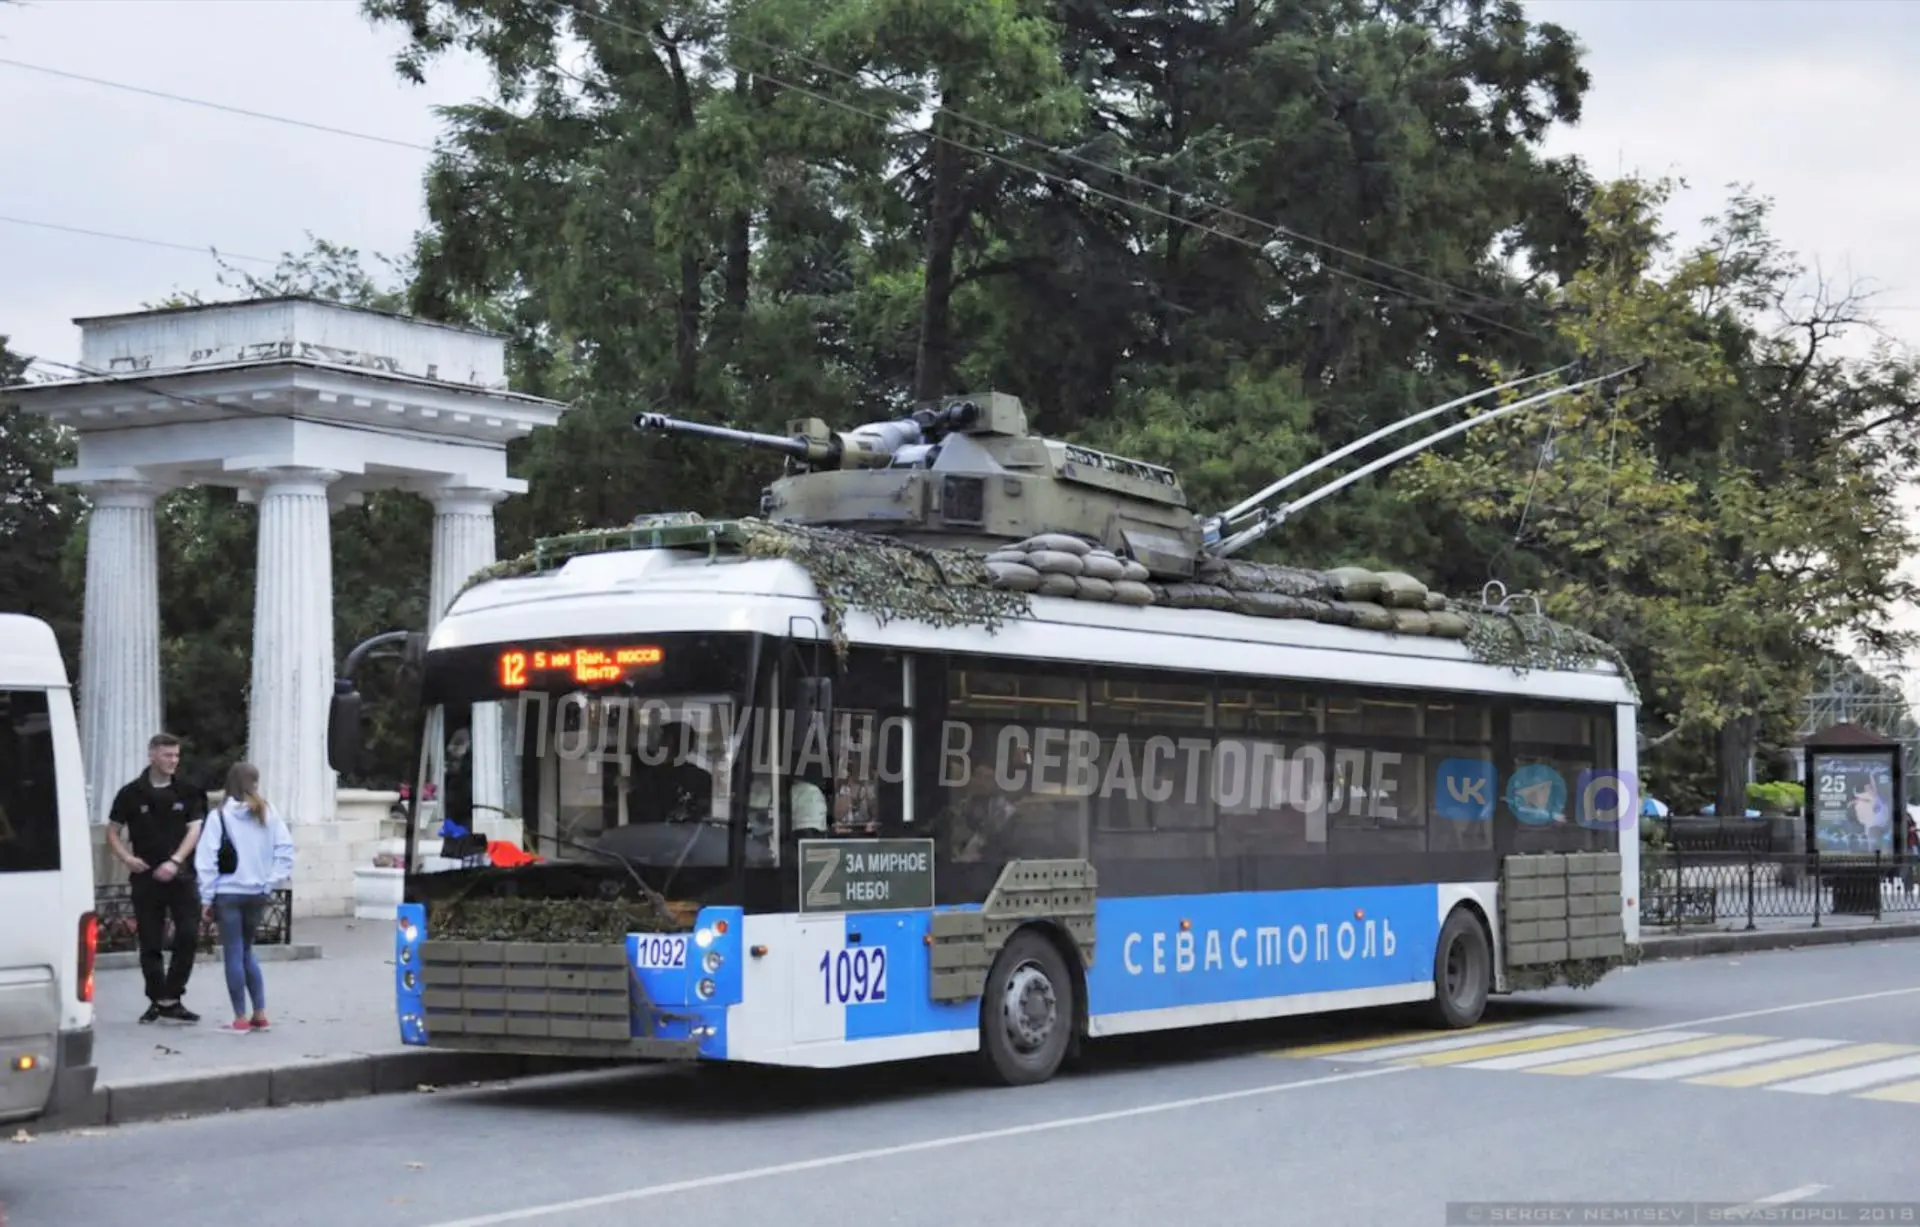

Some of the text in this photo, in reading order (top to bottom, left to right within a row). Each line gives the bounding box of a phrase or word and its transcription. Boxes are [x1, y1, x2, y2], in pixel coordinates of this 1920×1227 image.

[502, 653, 525, 686] 12
[534, 652, 546, 668] 5
[1820, 775, 1847, 793] 25
[845, 852, 927, 873] ЗА МИРНОЕ
[805, 848, 841, 907] Z
[845, 880, 889, 900] НЕБО!
[639, 938, 686, 967] 1092
[1123, 919, 1397, 976] СЕВАСТОПОЛЬ
[819, 947, 886, 1005] 1092
